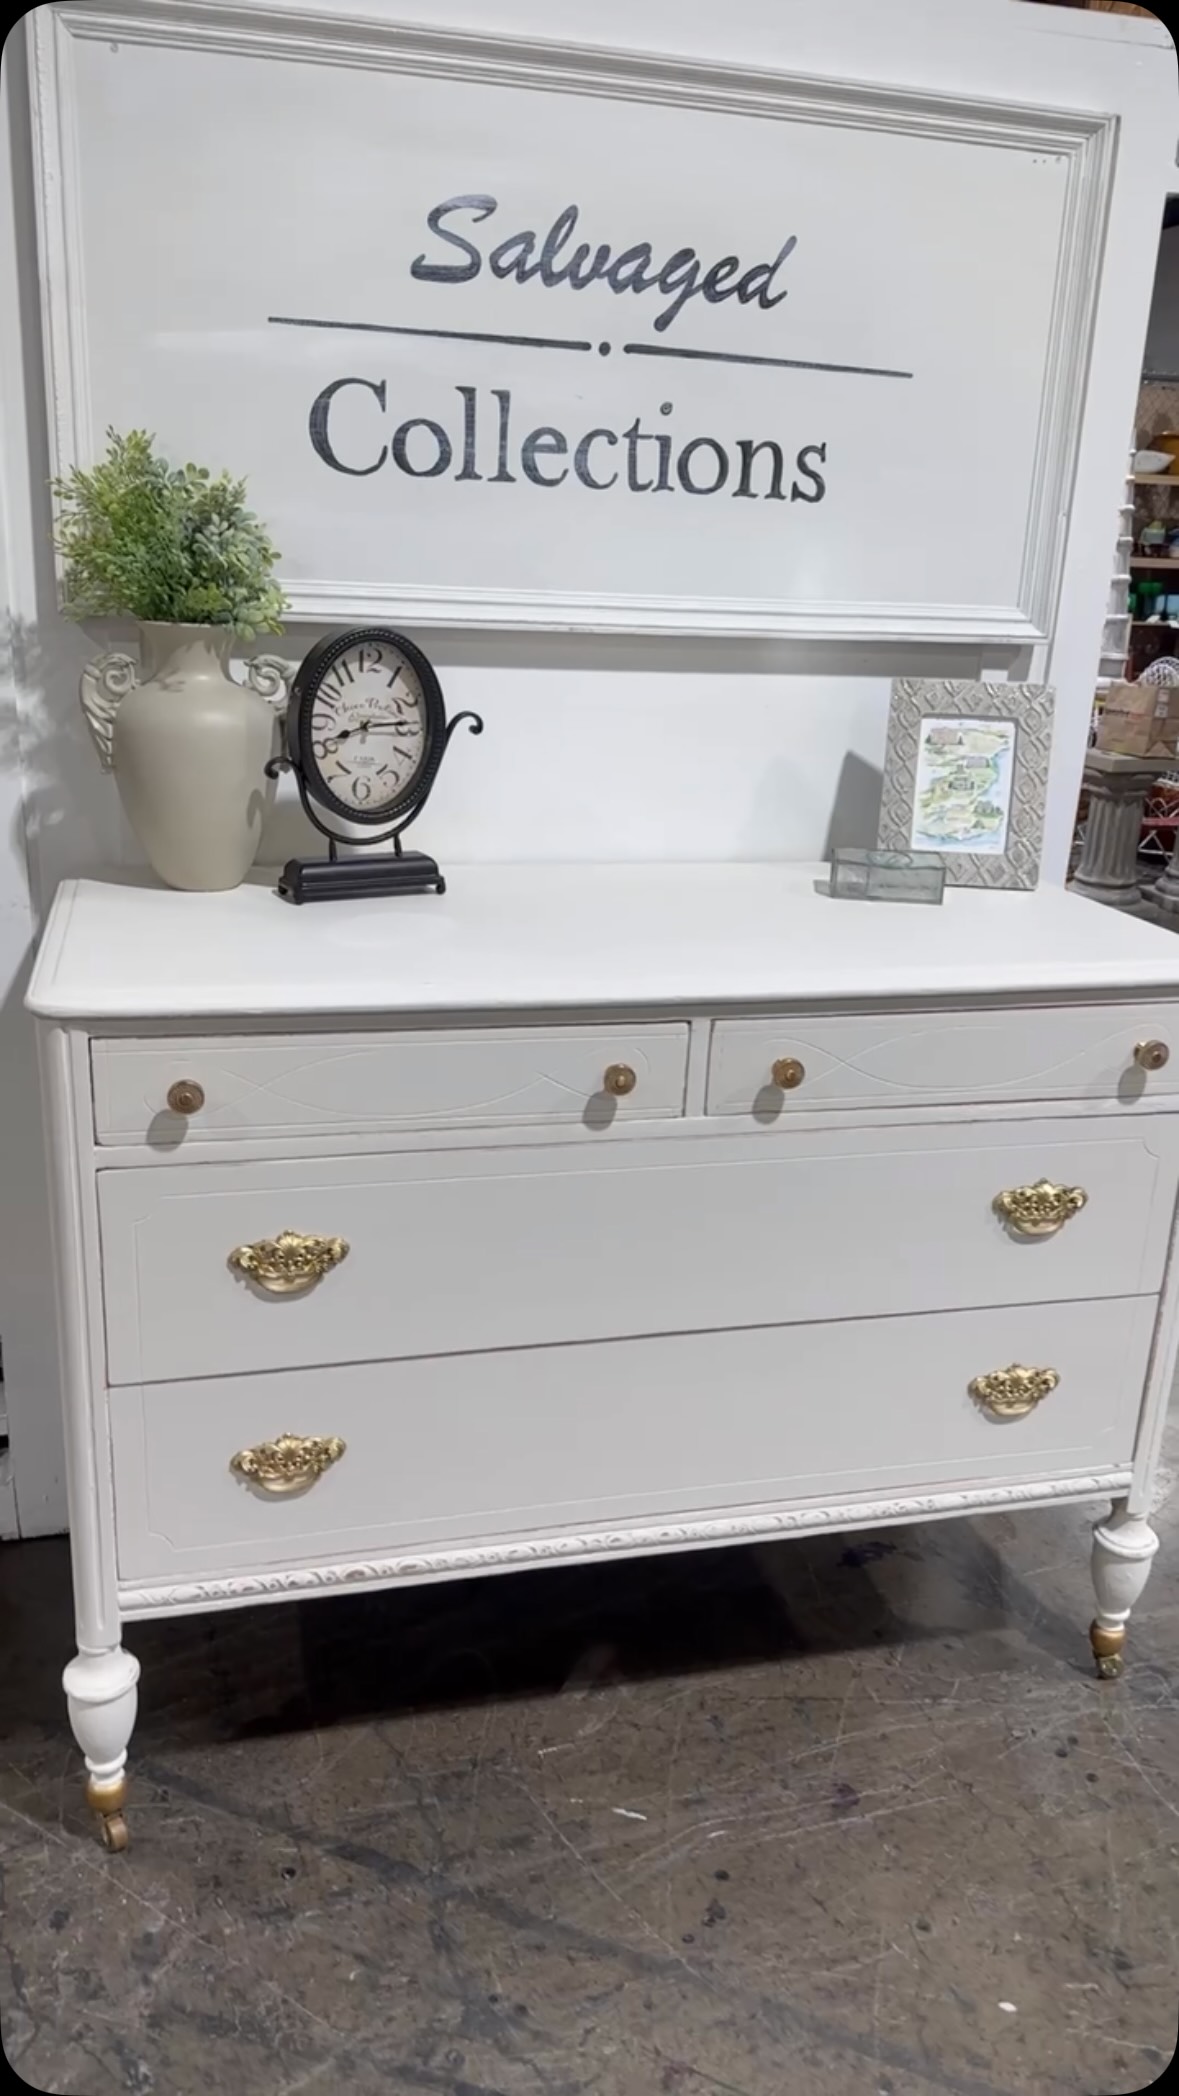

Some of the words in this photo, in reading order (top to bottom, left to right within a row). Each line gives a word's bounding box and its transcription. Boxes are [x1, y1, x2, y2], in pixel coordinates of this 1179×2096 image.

[410, 194, 797, 331] Salvaged
[308, 377, 828, 503] Collections
[332, 658, 355, 686] 11
[358, 648, 382, 673] 12
[386, 666, 402, 688] 1
[316, 682, 342, 709] 10
[391, 691, 418, 715] 2
[311, 713, 336, 731] 9
[395, 721, 420, 737] 3
[312, 737, 339, 760] 8
[393, 745, 413, 767] 4
[327, 760, 352, 783] 7
[376, 764, 400, 793] 5
[351, 775, 371, 801] 6
